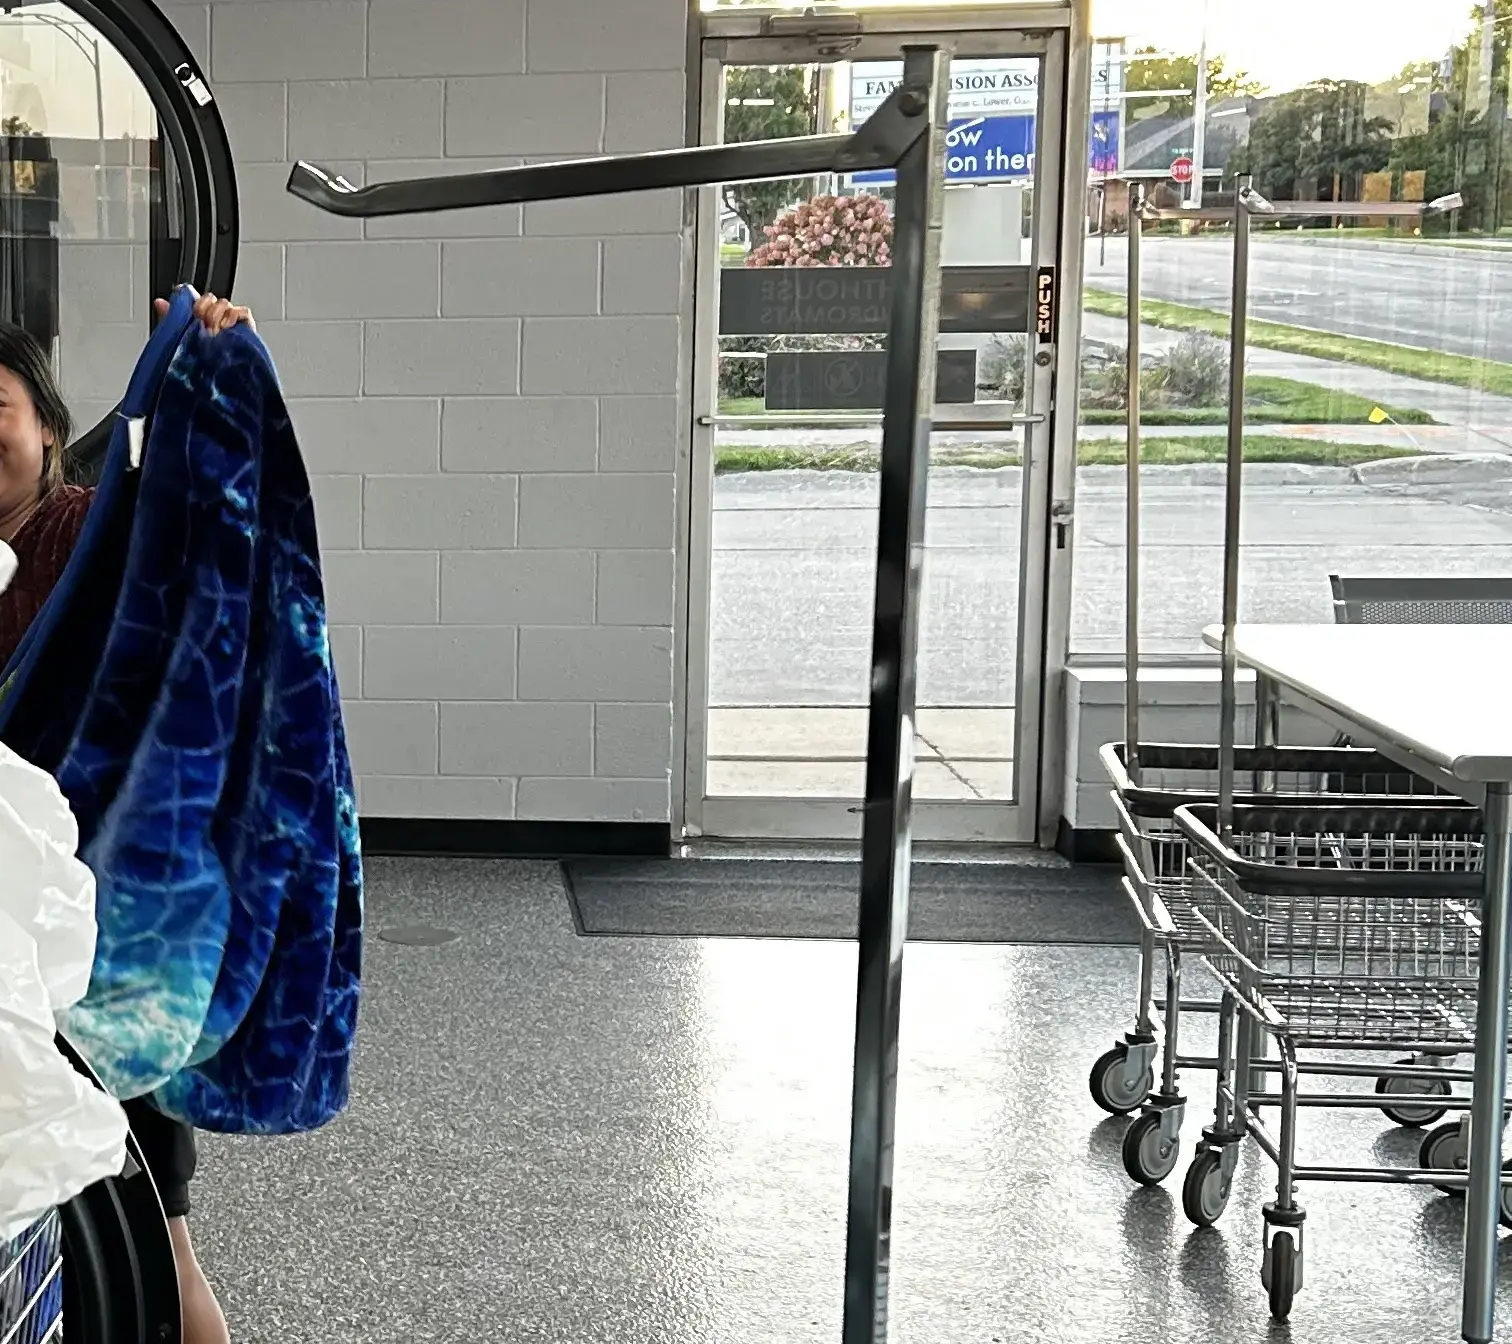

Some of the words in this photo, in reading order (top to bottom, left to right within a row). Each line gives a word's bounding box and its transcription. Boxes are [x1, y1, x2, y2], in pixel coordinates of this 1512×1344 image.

[865, 80, 904, 95] FAM
[948, 74, 997, 90] ISION
[1038, 274, 1052, 334] PUSH
